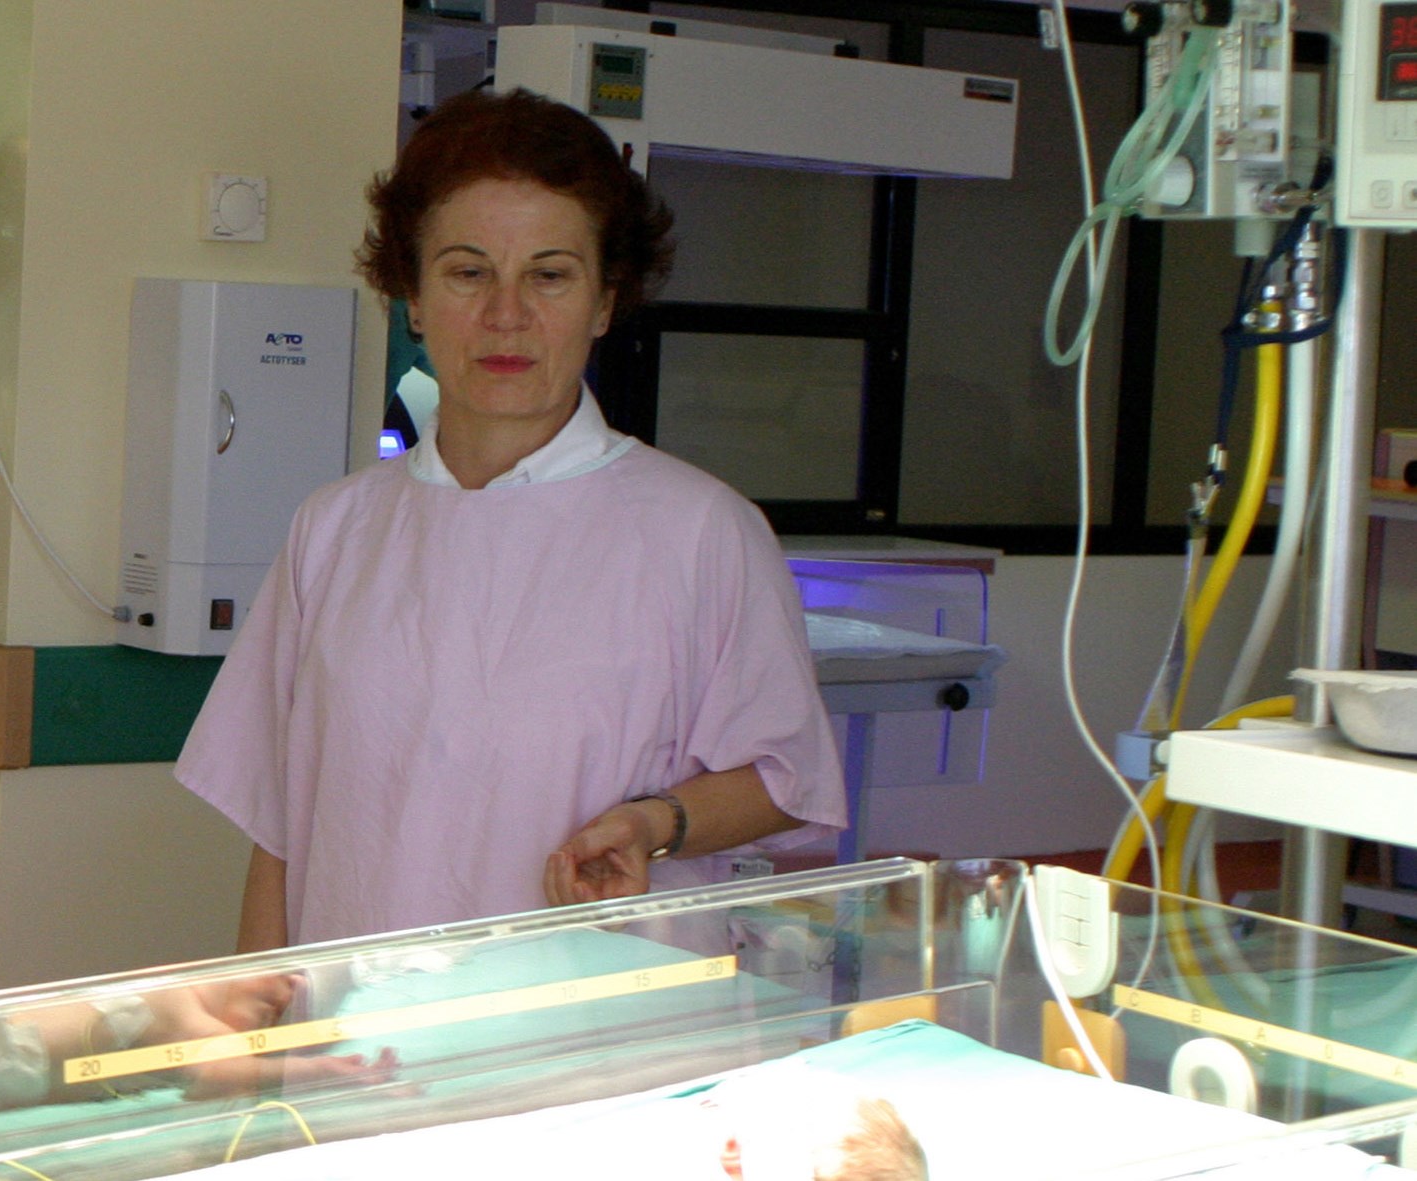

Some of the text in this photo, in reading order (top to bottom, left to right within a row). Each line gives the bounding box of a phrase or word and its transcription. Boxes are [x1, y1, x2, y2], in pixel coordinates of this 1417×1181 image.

[81, 1060, 101, 1076] 20
[166, 1047, 184, 1063] 15
[247, 1034, 266, 1050] 10
[635, 973, 651, 988] 15
[706, 961, 723, 976] 20
[1129, 992, 1139, 1007] C
[1191, 1008, 1201, 1023] B
[1256, 1026, 1267, 1041] A
